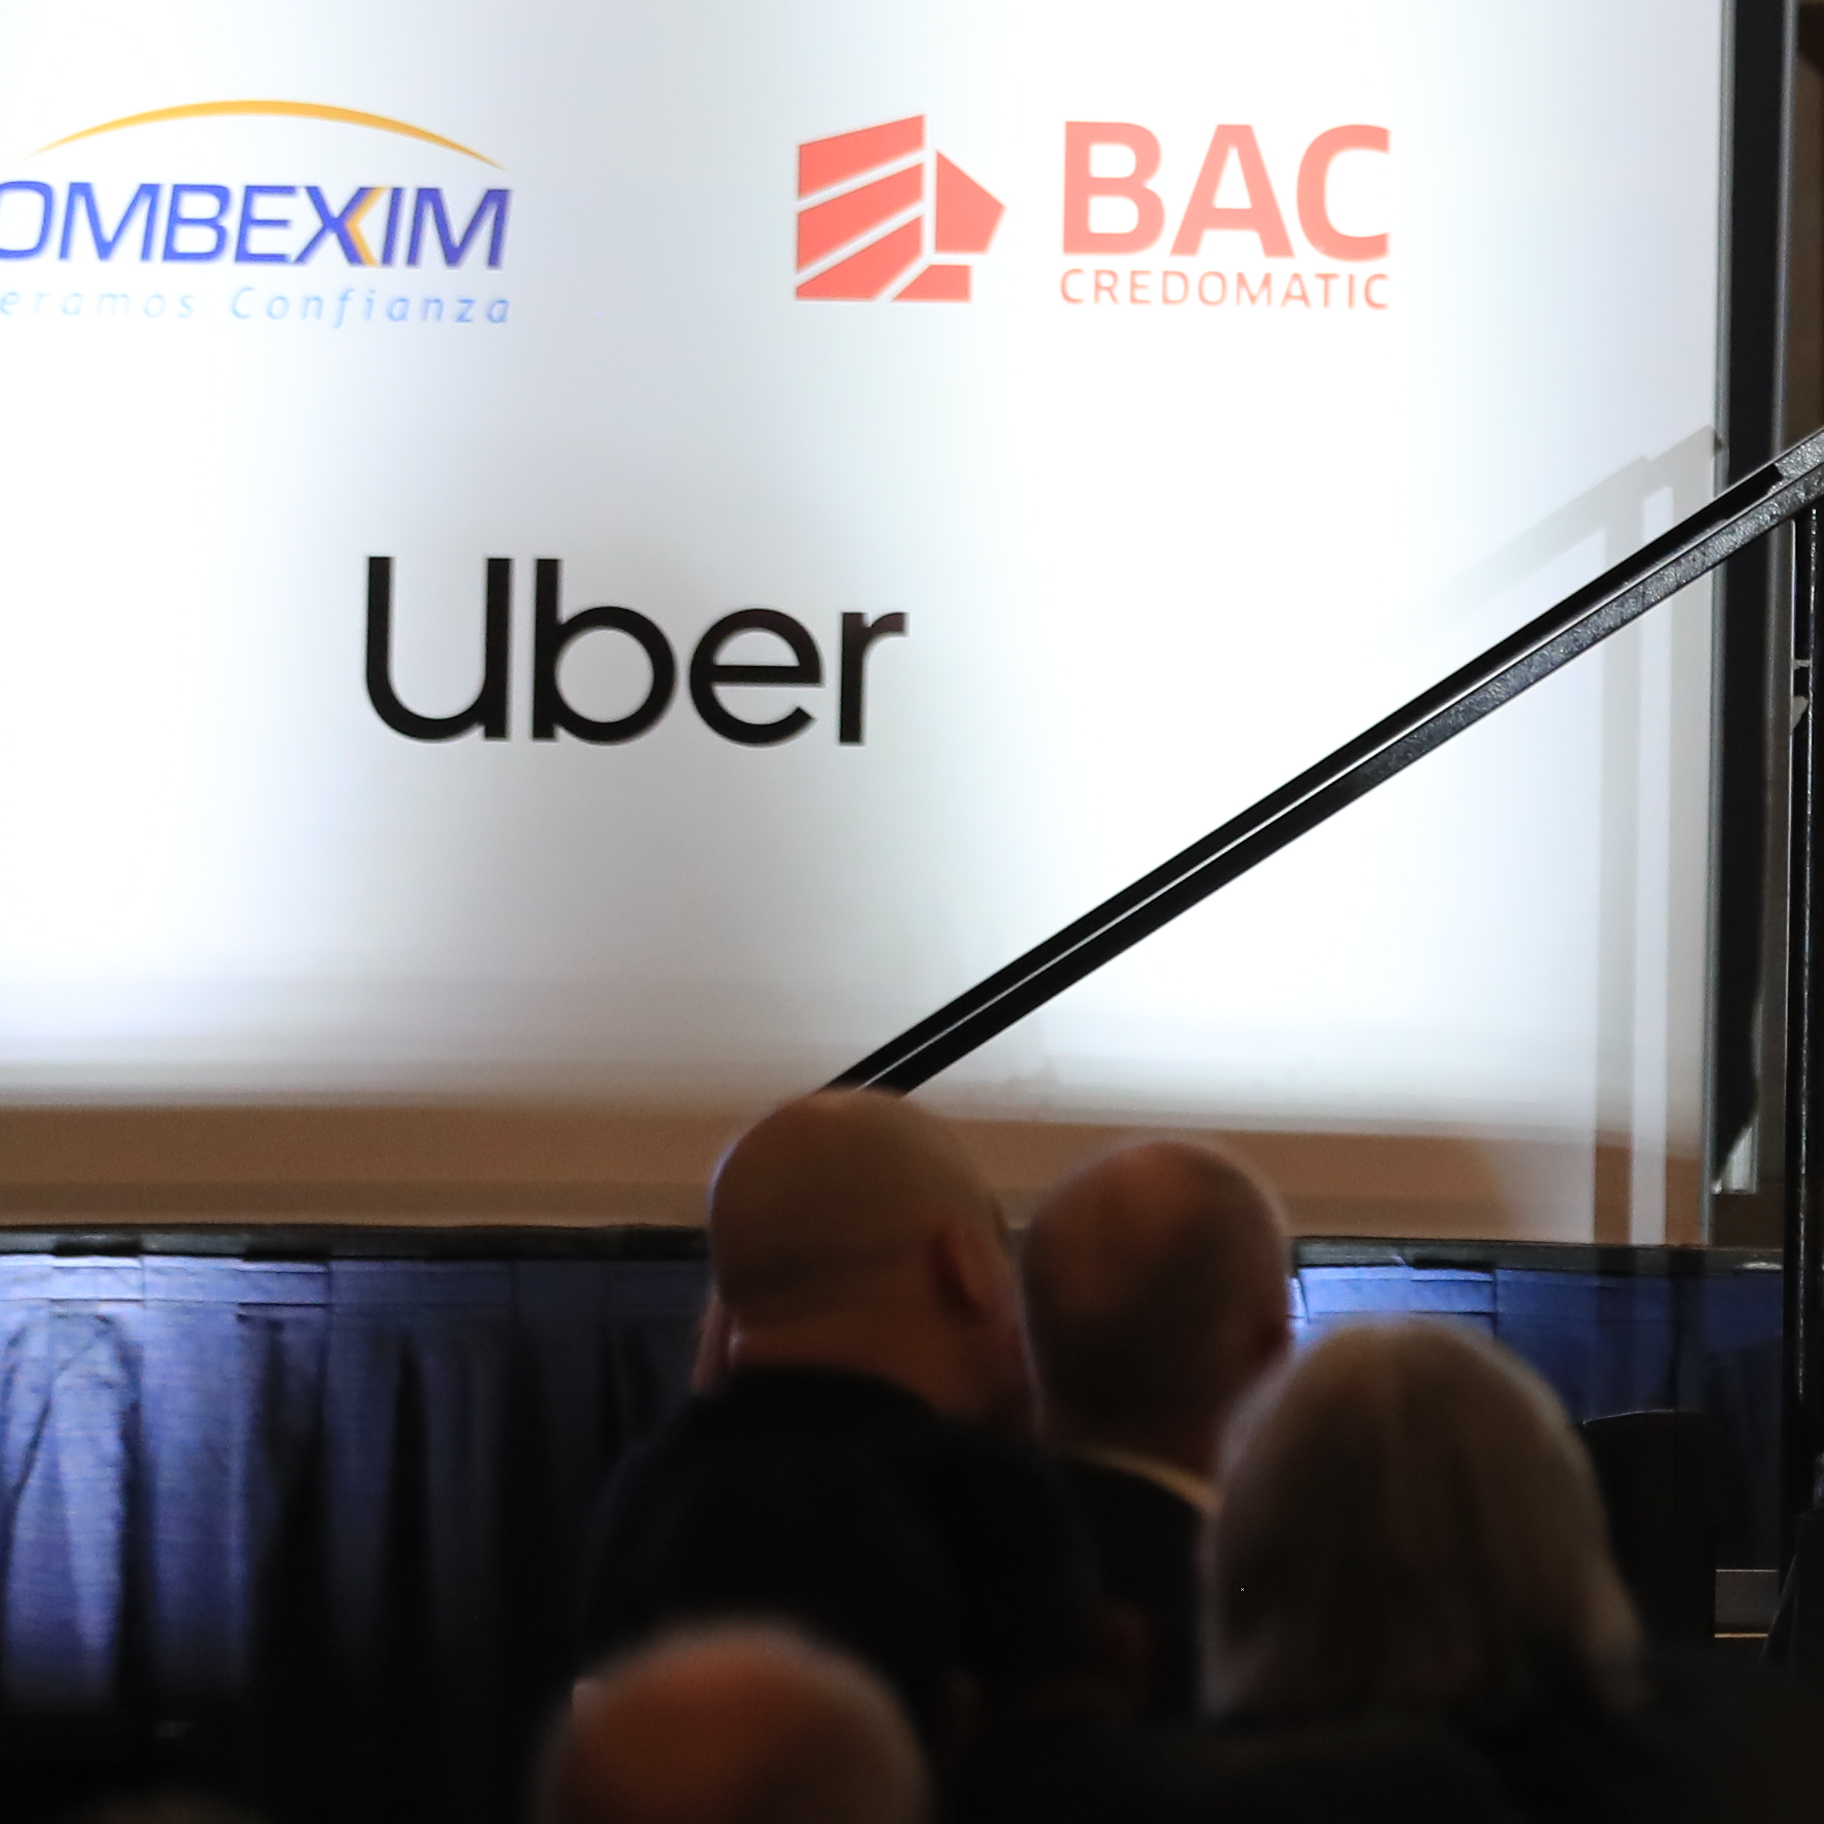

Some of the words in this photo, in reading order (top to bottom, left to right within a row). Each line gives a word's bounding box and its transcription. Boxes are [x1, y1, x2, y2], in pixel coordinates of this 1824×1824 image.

[1061, 119, 1391, 259] BAC
[231, 285, 510, 329] Confianza
[1060, 267, 1391, 311] CREDOMATIC
[365, 556, 908, 747] Uber
